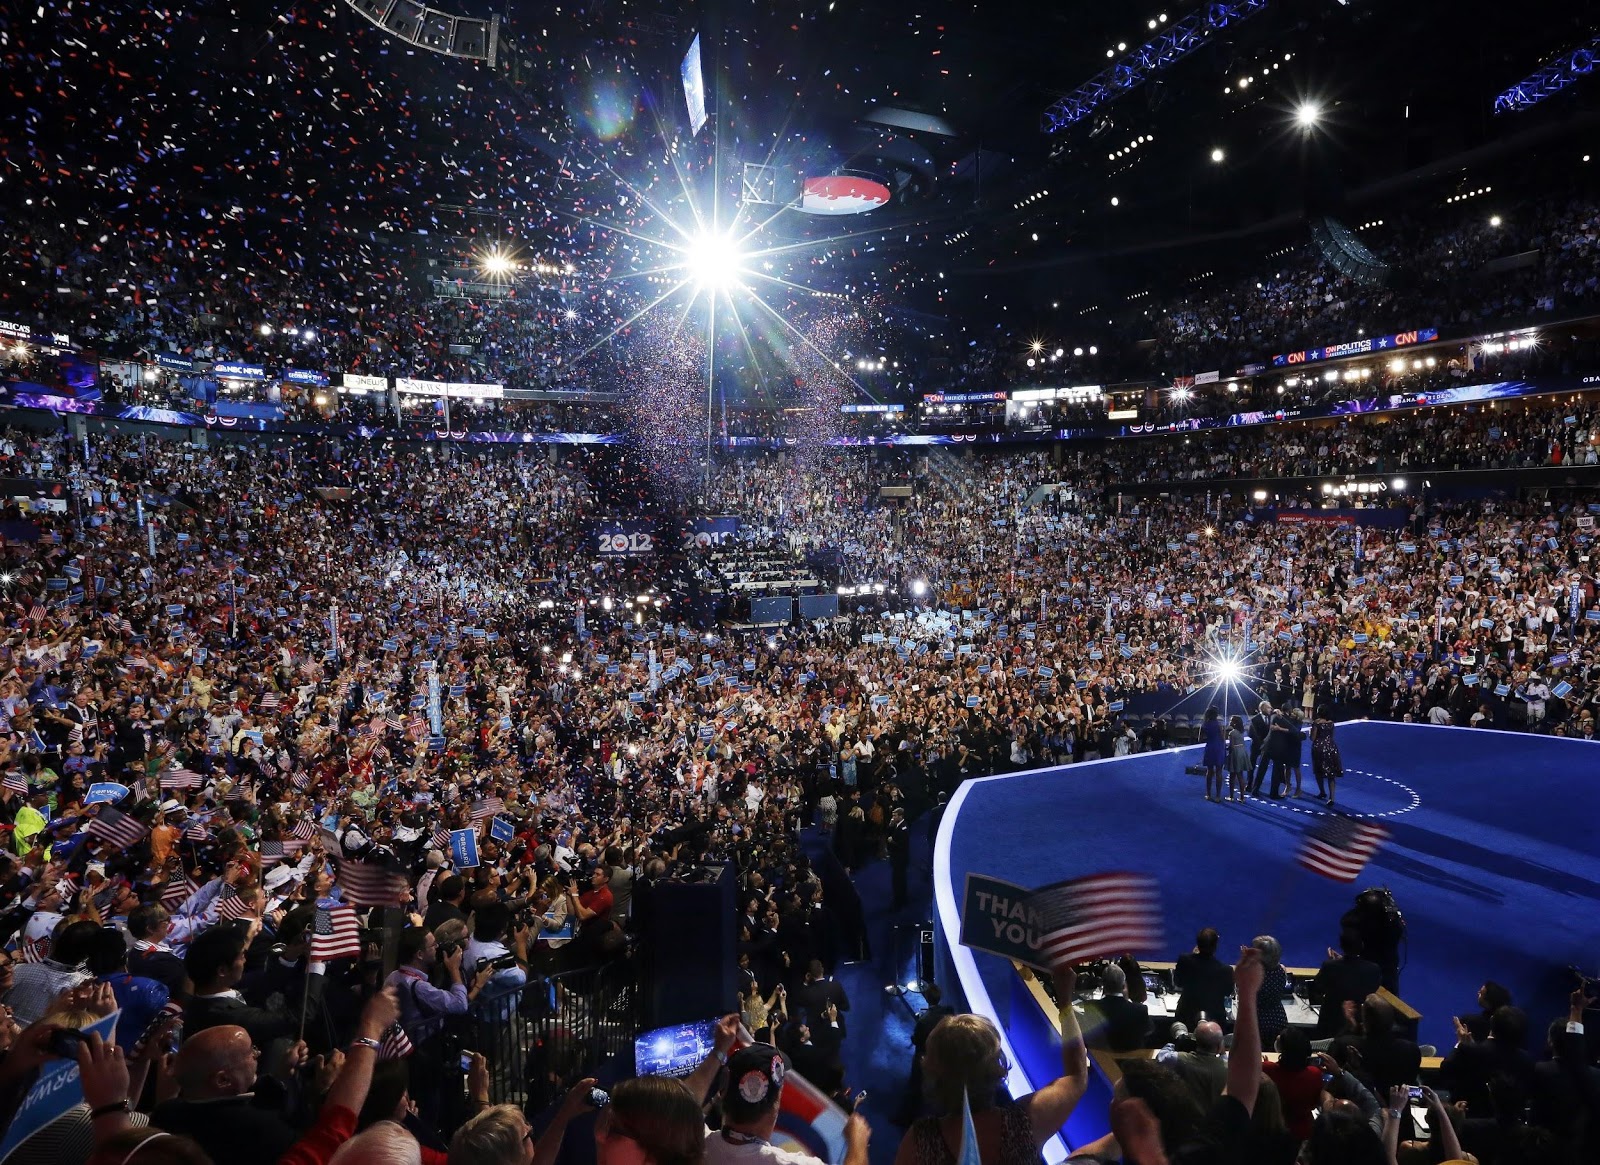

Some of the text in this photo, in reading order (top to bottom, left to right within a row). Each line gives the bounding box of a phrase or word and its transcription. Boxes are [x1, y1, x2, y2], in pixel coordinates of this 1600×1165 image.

[1326, 339, 1371, 353] CNN POLITICS
[1395, 331, 1418, 345] CNN
[162, 357, 192, 366] TELEMUNDO
[1287, 351, 1306, 364] CNN
[227, 365, 264, 376] NBC NEWS
[598, 533, 653, 552] 2012
[1570, 585, 1578, 618] WASHINGTON
[459, 832, 470, 865] FORWARD
[975, 891, 1044, 926] THAN
[990, 917, 1044, 951] YOU
